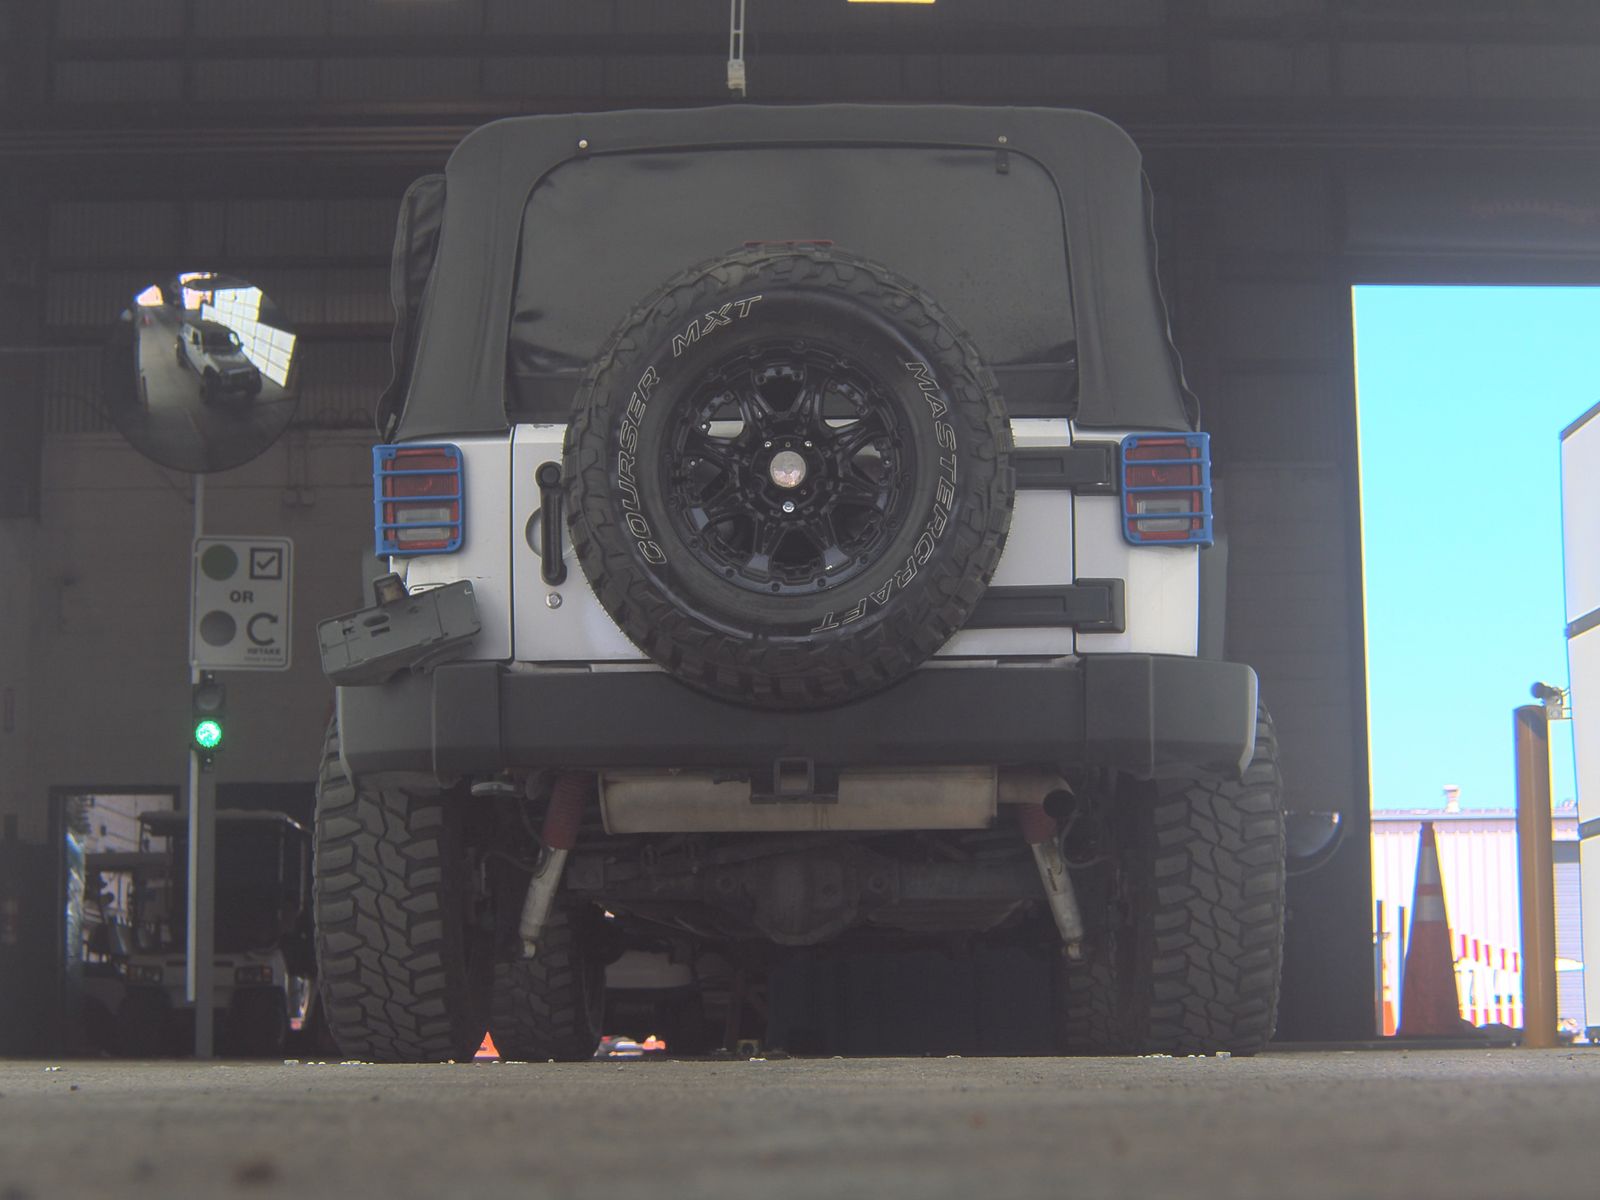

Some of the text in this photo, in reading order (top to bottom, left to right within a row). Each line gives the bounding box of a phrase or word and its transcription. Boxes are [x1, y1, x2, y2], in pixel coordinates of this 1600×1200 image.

[618, 295, 763, 564] COURSER MXT
[810, 362, 957, 633] MASTERCRAFT
[229, 590, 255, 603] OR
